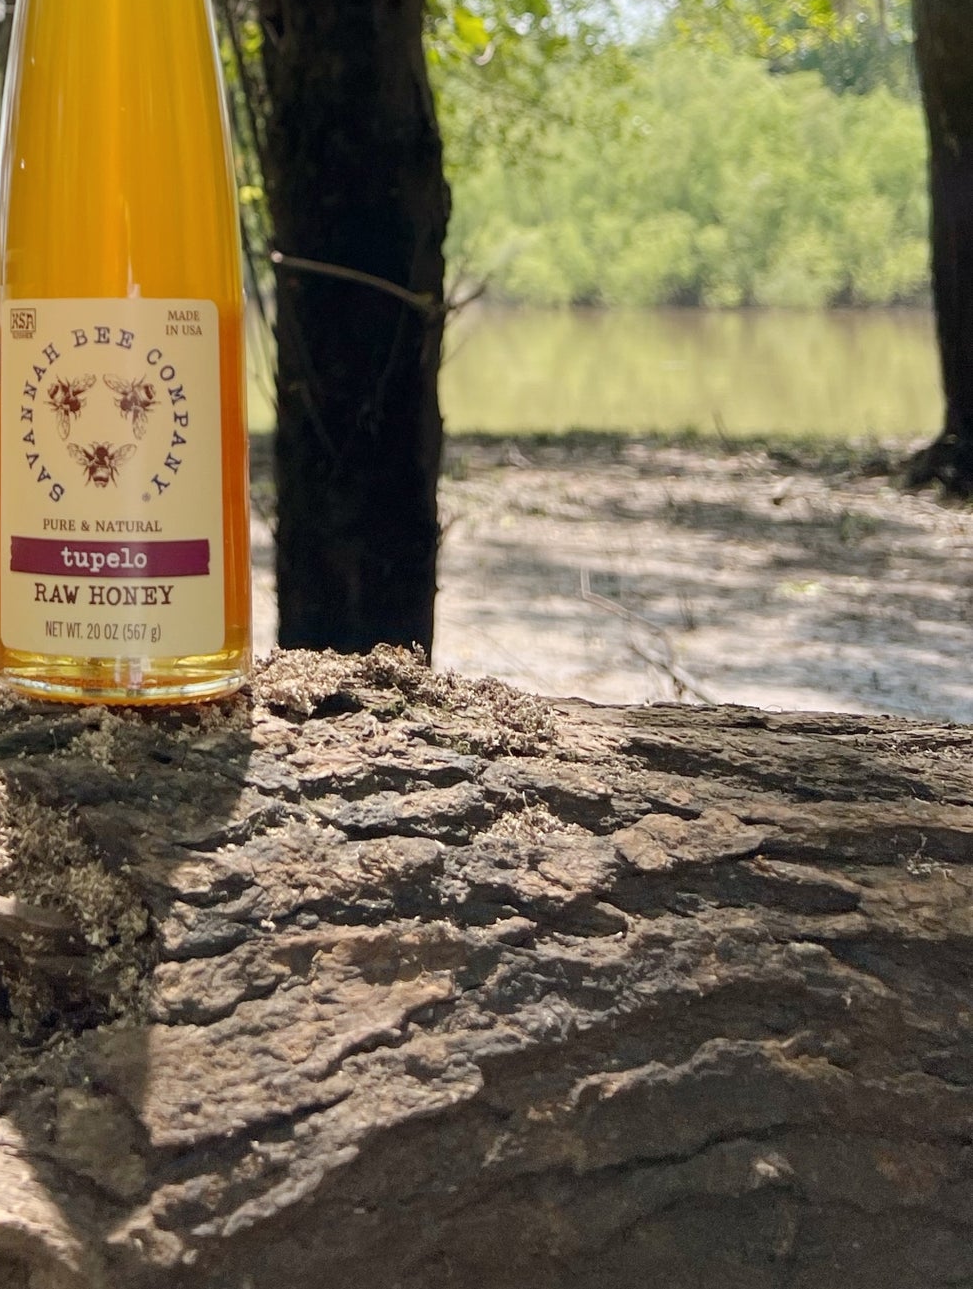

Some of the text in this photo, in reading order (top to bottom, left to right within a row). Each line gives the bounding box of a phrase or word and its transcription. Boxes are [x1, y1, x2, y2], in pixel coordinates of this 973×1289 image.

[168, 310, 200, 322] MADE
[165, 325, 203, 336] IN USA
[21, 326, 189, 503] SAVANNAH BEE COMPANY
[43, 518, 162, 532] PURE & NATURAL
[60, 546, 147, 572] tupelo
[34, 583, 174, 605] RAW HONEY
[45, 621, 161, 642] NET WT. 20 OZ (567 g)
